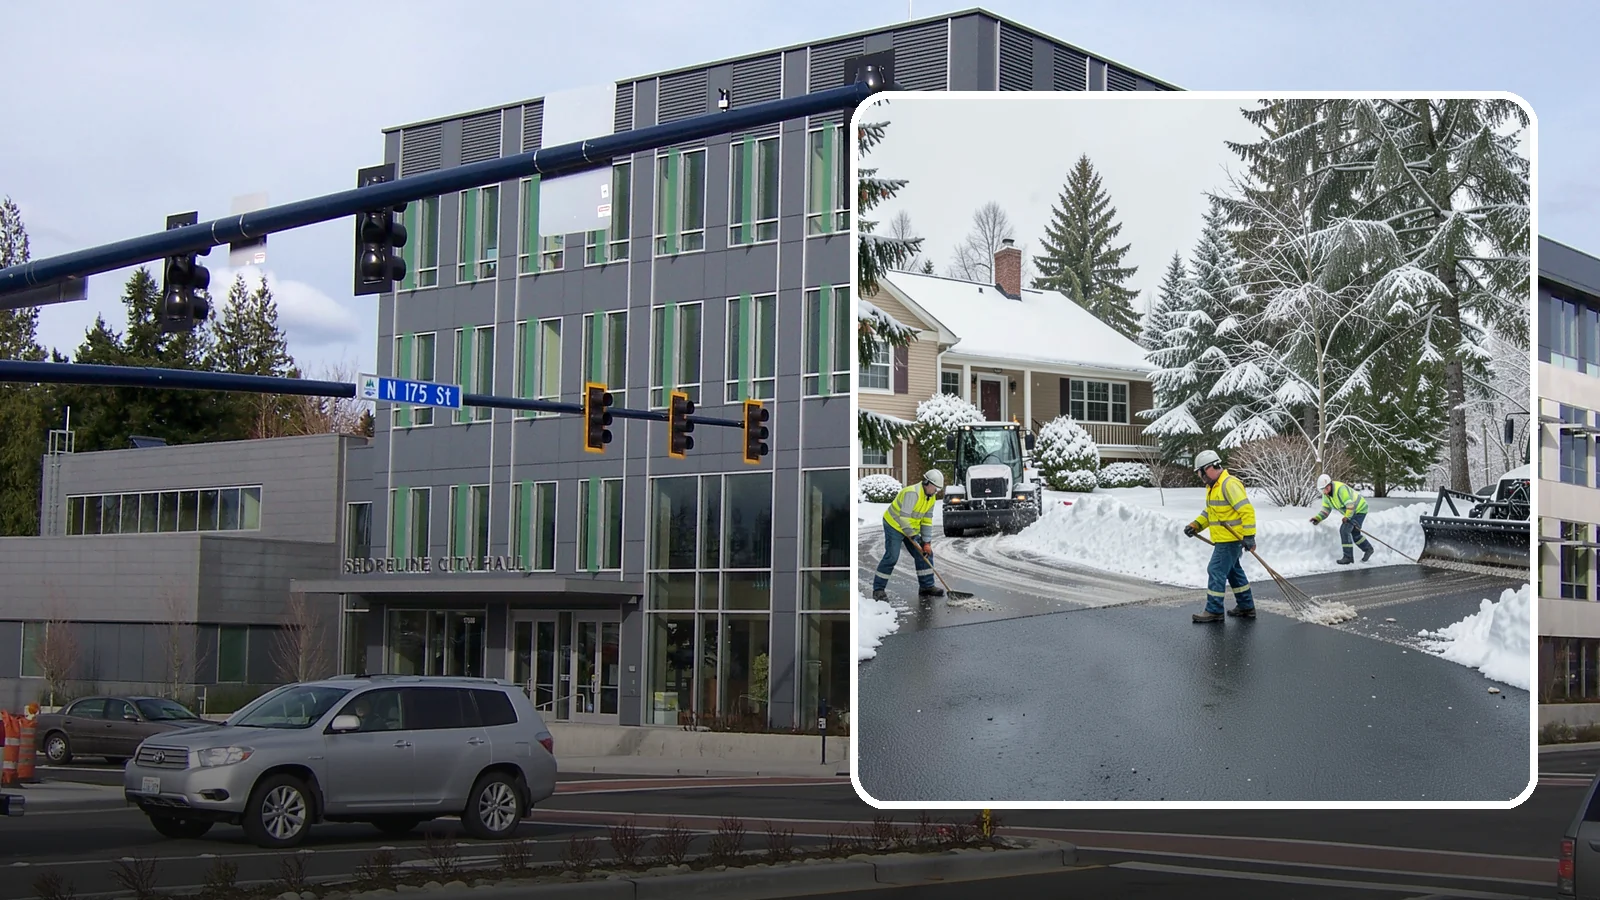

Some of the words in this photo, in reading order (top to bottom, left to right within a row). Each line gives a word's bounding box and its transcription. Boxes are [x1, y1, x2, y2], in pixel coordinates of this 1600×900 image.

[387, 380, 396, 399] N
[405, 382, 427, 403] 175
[436, 386, 451, 406] St
[344, 556, 432, 575] SHORELINE
[438, 555, 476, 573] CITY
[483, 555, 525, 573] HALL
